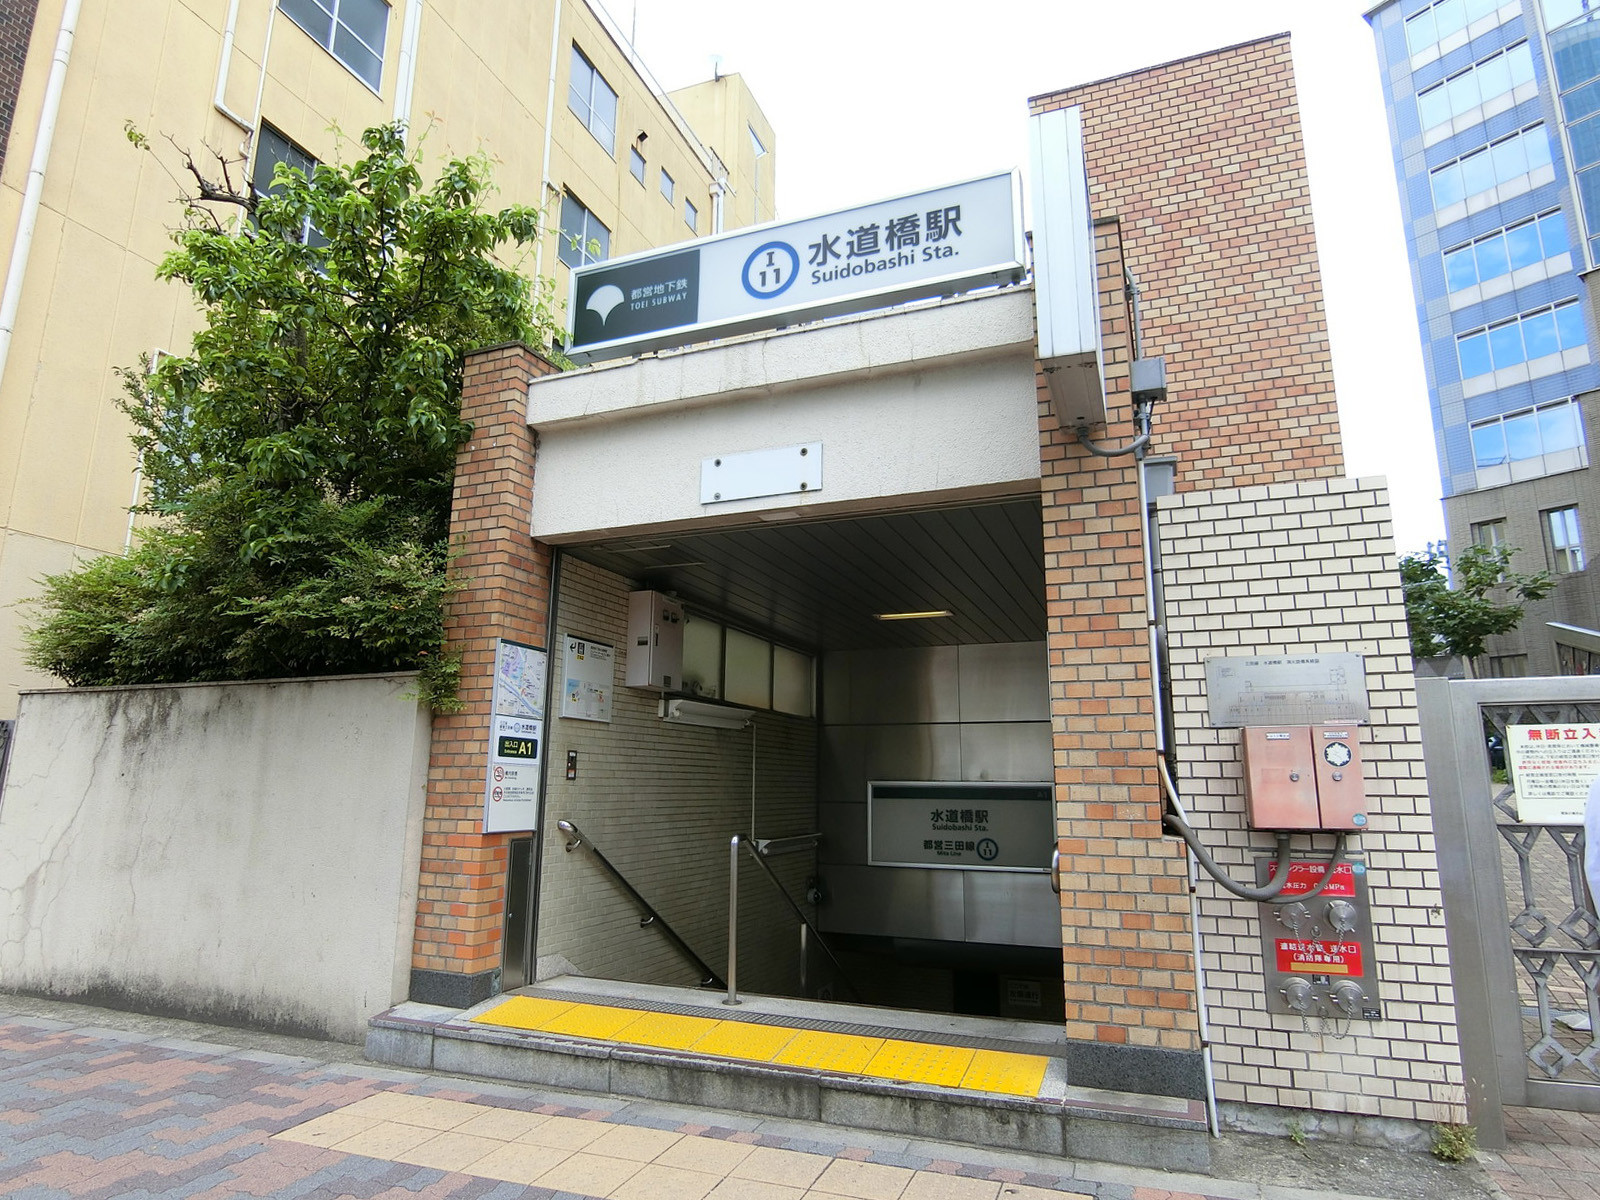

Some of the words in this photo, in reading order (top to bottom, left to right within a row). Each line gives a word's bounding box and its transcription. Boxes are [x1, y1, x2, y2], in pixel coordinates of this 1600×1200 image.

[807, 205, 963, 267] 水道橋駅
[765, 251, 776, 268] I
[811, 250, 915, 285] Suidobashi
[922, 245, 960, 263] Sta.
[759, 268, 781, 287] 11
[630, 278, 688, 300] 都営地下鉄
[630, 300, 649, 311] TOEI
[651, 292, 688, 307] SUBWAY
[1528, 728, 1600, 740] 無断立入
[518, 741, 532, 755] A1
[930, 808, 989, 824] 水道橋駅
[932, 823, 973, 831] Suidobashi
[974, 823, 989, 832] Sta.
[923, 839, 975, 851] 都営三田線
[983, 848, 992, 856] 11
[1329, 944, 1357, 954] 送水口
